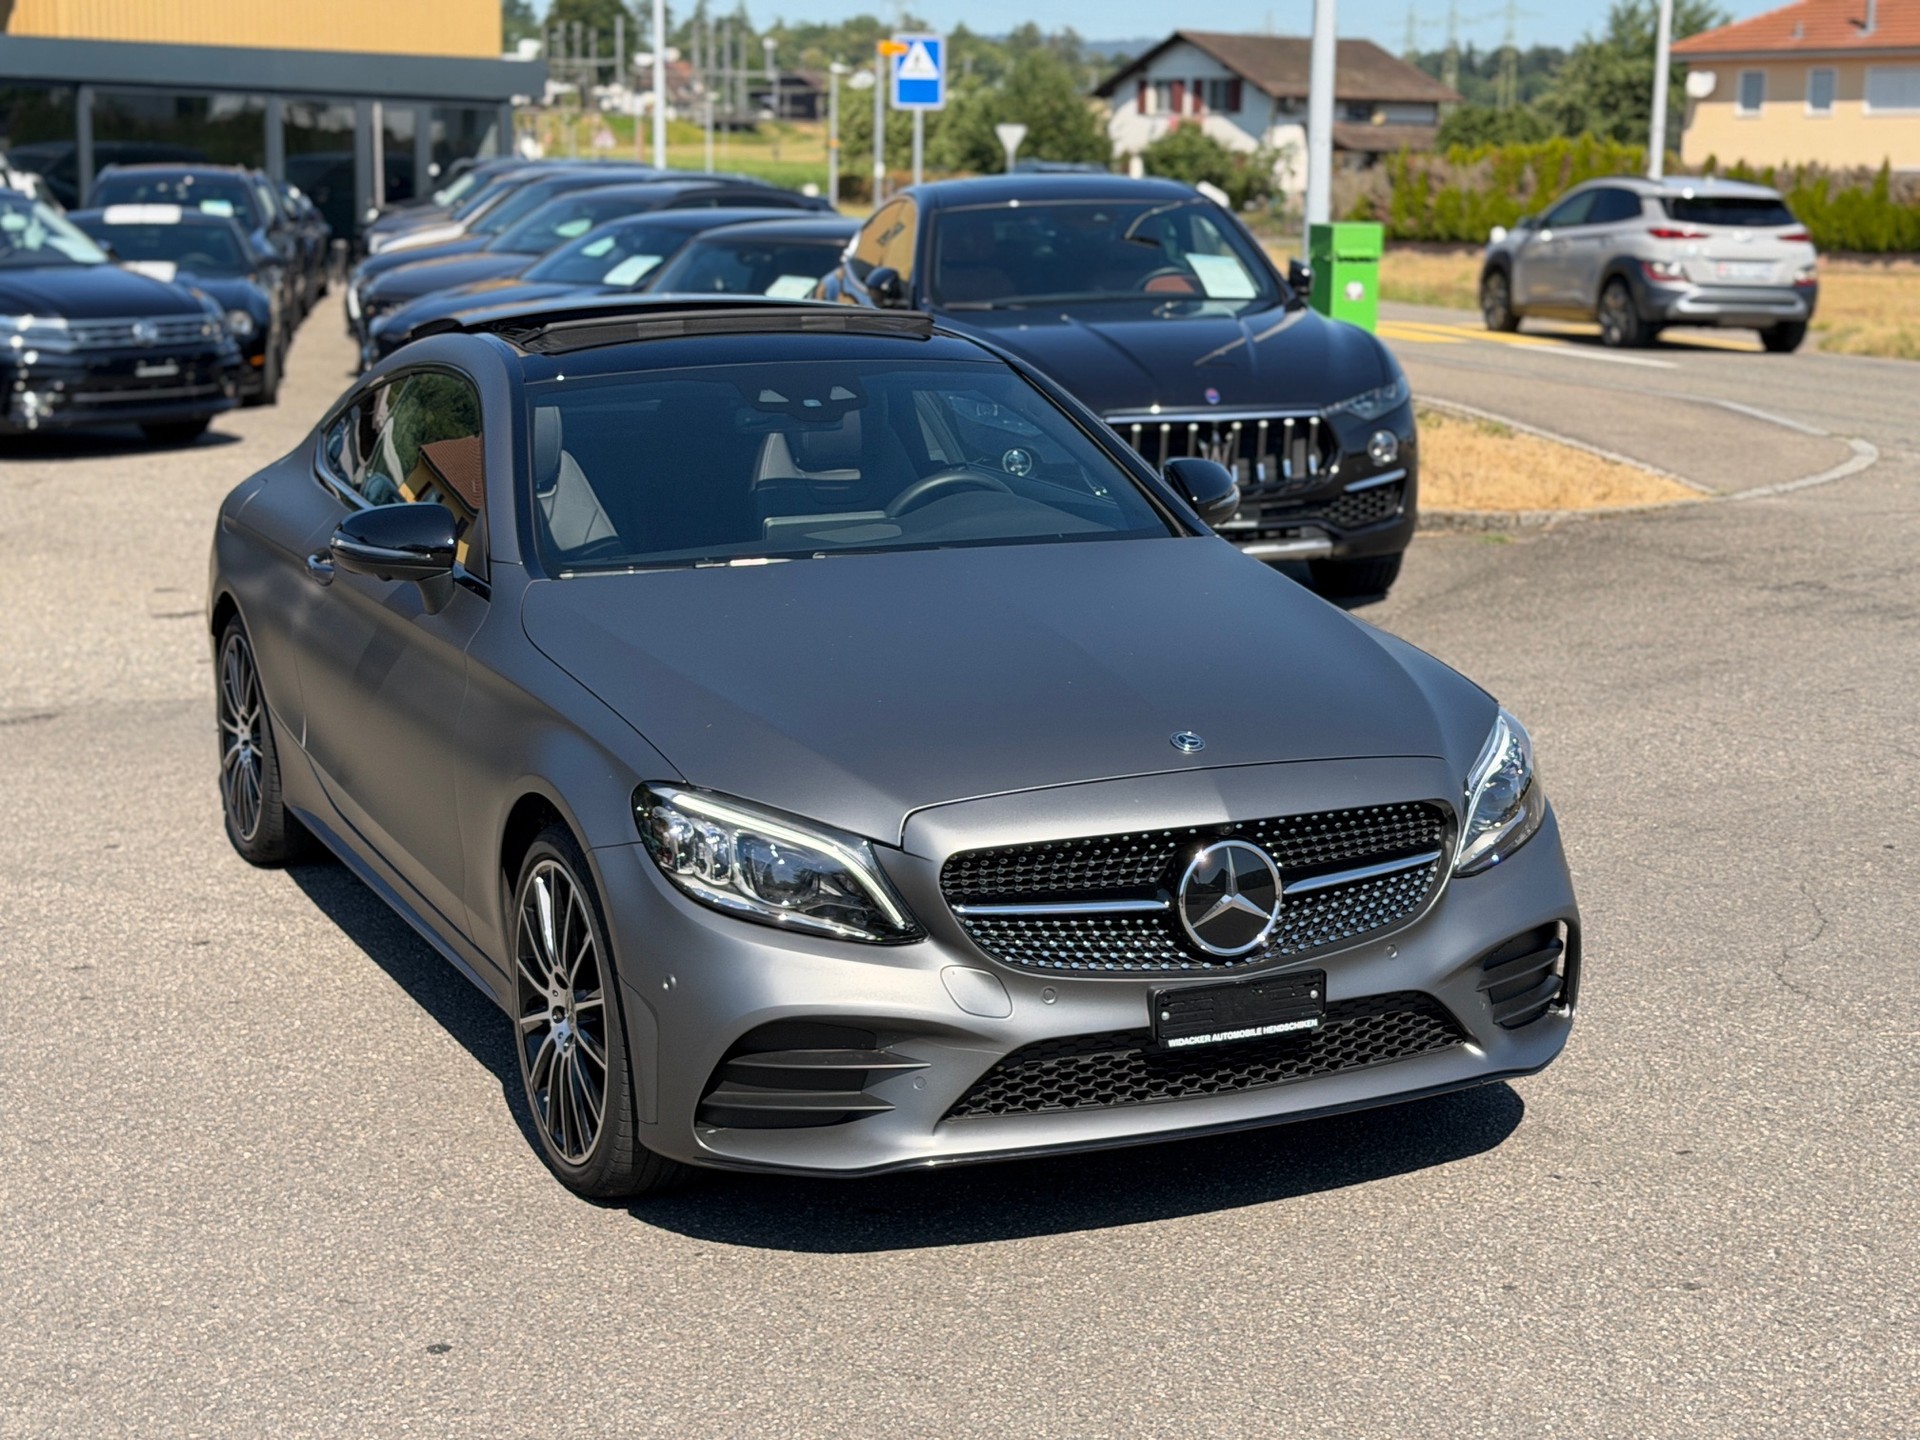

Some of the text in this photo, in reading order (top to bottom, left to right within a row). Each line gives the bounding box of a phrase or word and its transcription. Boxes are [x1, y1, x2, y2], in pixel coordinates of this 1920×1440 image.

[1168, 1018, 1318, 1047] WIDACKER AUTOMOBILE HENDSCHIKEN
